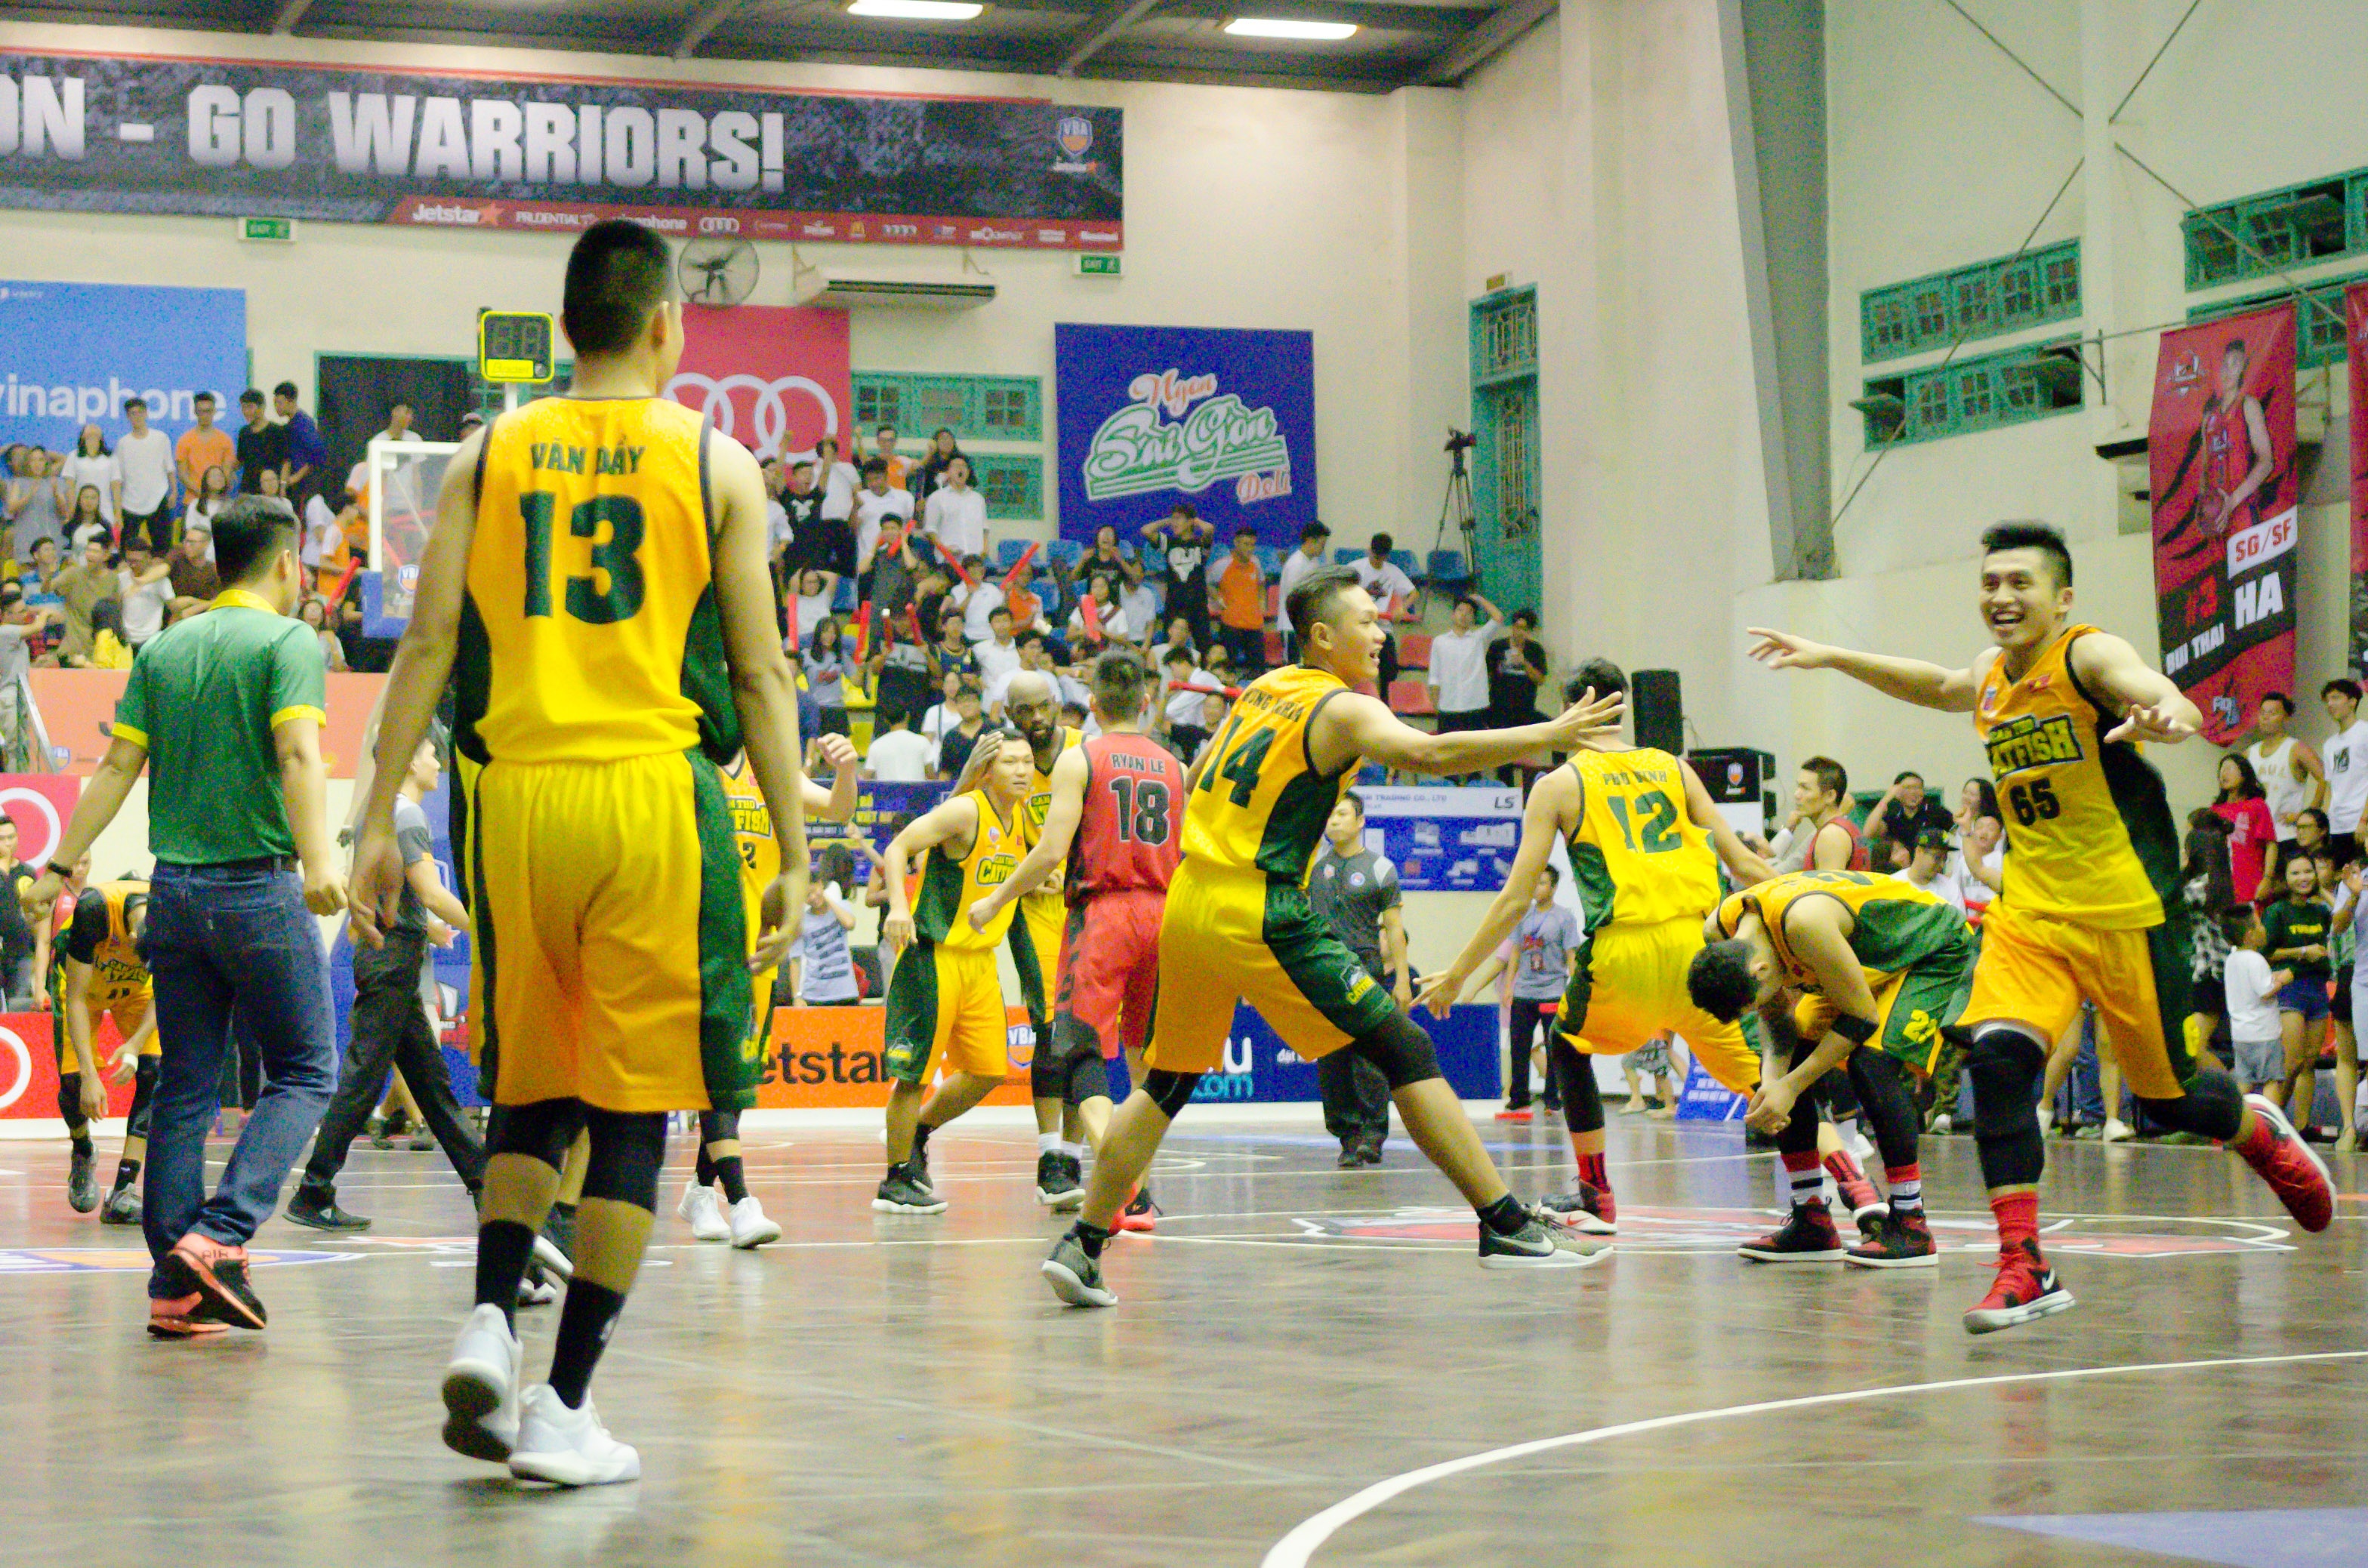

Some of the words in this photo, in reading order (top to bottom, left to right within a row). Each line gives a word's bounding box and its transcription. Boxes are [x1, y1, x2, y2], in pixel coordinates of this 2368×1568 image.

[119, 122, 154, 141] -
[188, 84, 296, 169] GO
[328, 91, 784, 193] WARRIORS!
[412, 204, 481, 224] Jetstar
[515, 211, 581, 226] PRUDENTIAL
[0, 373, 227, 424] inaphone
[520, 489, 646, 625] 13
[2234, 517, 2292, 563] SG/SF
[2234, 571, 2284, 631] HA
[1149, 758, 1166, 775] LE
[1199, 715, 1277, 809] 14
[729, 806, 769, 836] FISH
[1109, 775, 1171, 847] 18
[1494, 796, 1515, 809] LS
[1607, 790, 1682, 854] 12
[2009, 778, 2061, 827] 65
[202, 1249, 229, 1260] AIR
